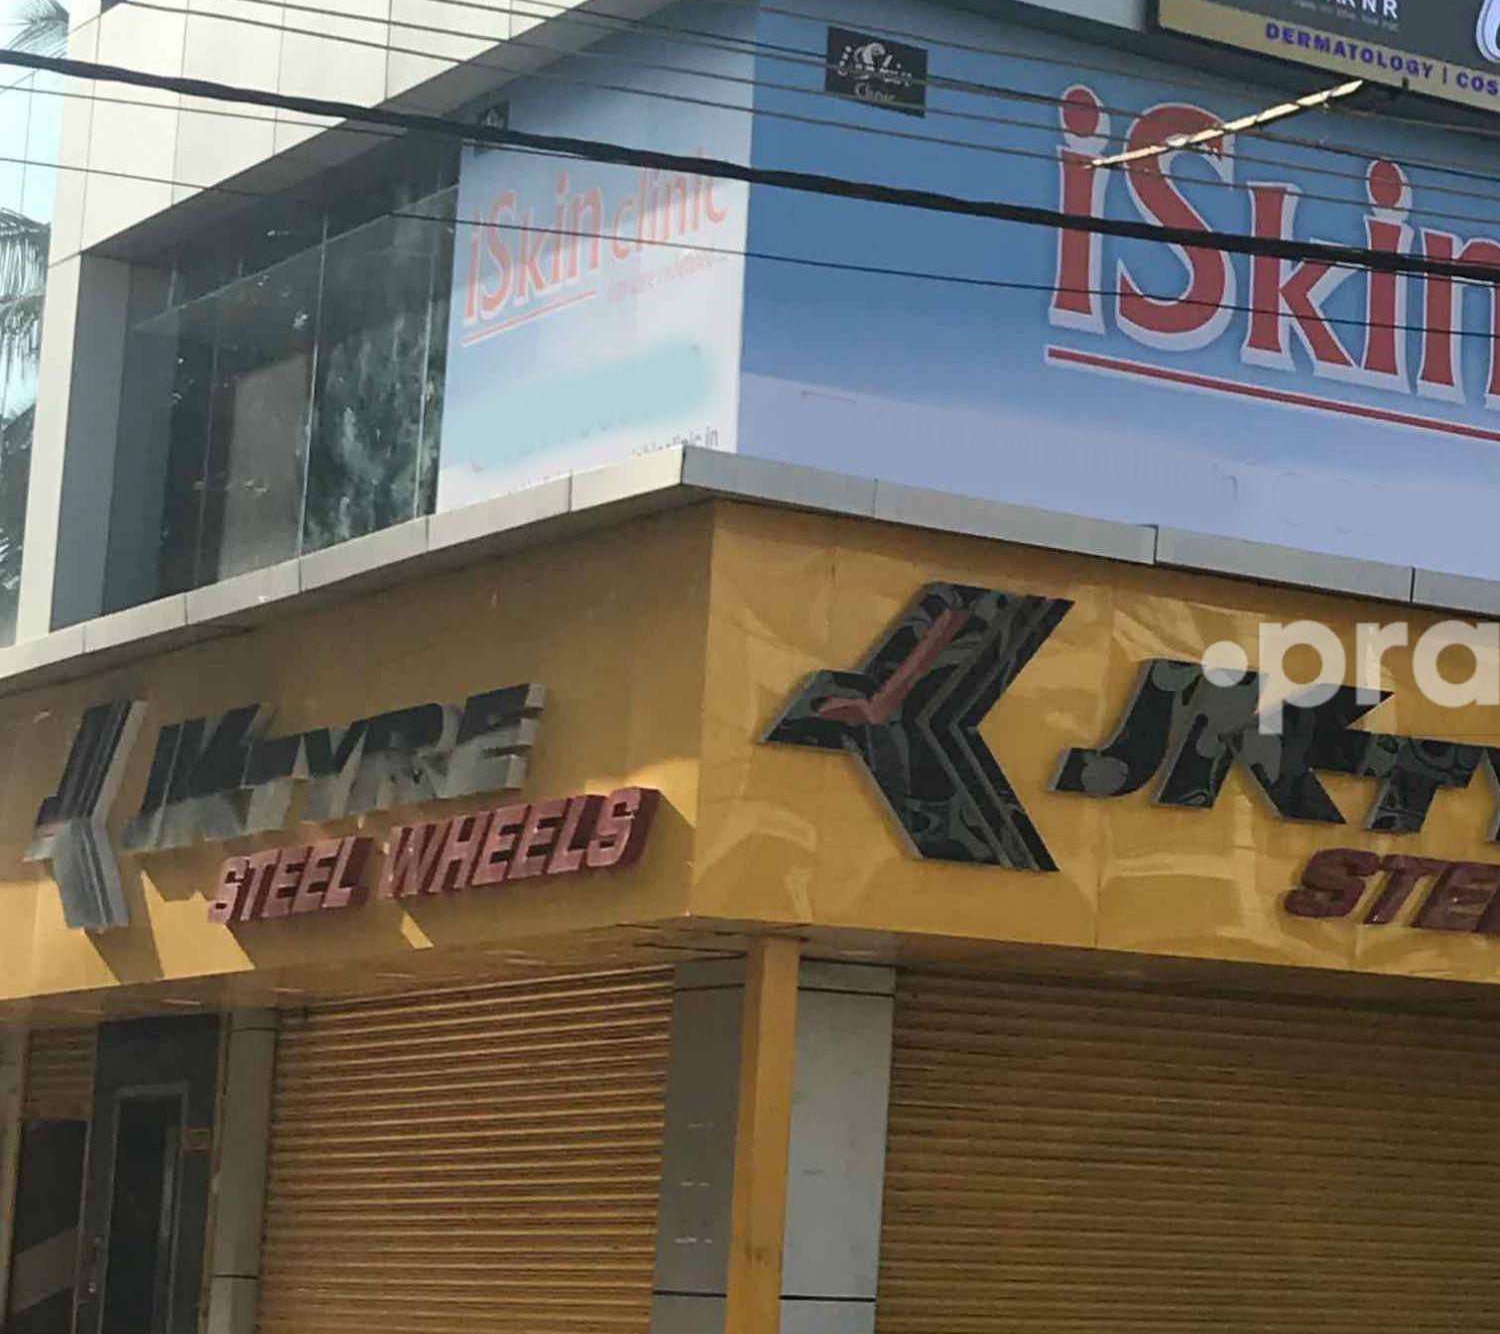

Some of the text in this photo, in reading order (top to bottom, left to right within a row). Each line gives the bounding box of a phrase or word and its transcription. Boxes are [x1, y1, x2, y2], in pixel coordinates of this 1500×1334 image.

[1265, 22, 1434, 79] DERMATOLOGY
[462, 171, 605, 328] iSkin
[208, 786, 660, 925] STEEL WHEELS
